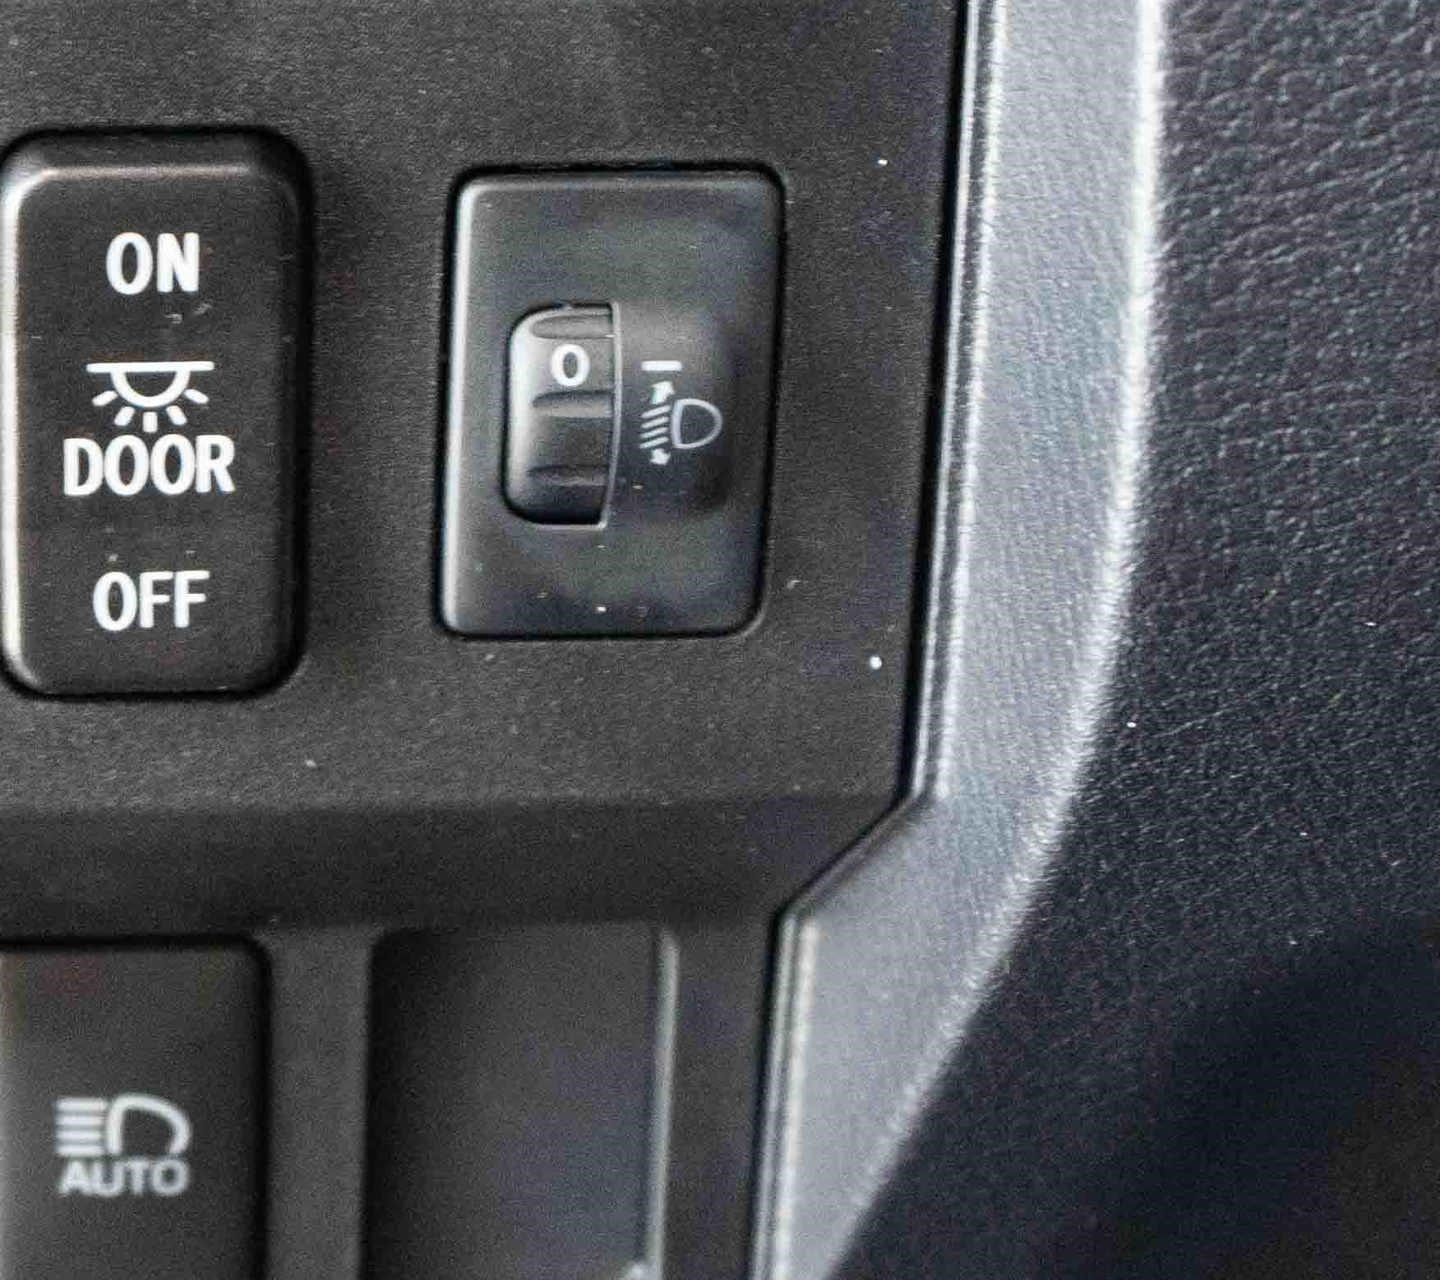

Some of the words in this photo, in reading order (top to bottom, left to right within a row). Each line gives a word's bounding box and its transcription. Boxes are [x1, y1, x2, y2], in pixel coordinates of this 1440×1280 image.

[105, 232, 200, 296] ON
[62, 434, 236, 498] DOOR
[92, 570, 212, 633] OFF
[58, 1158, 188, 1198] AUTO
